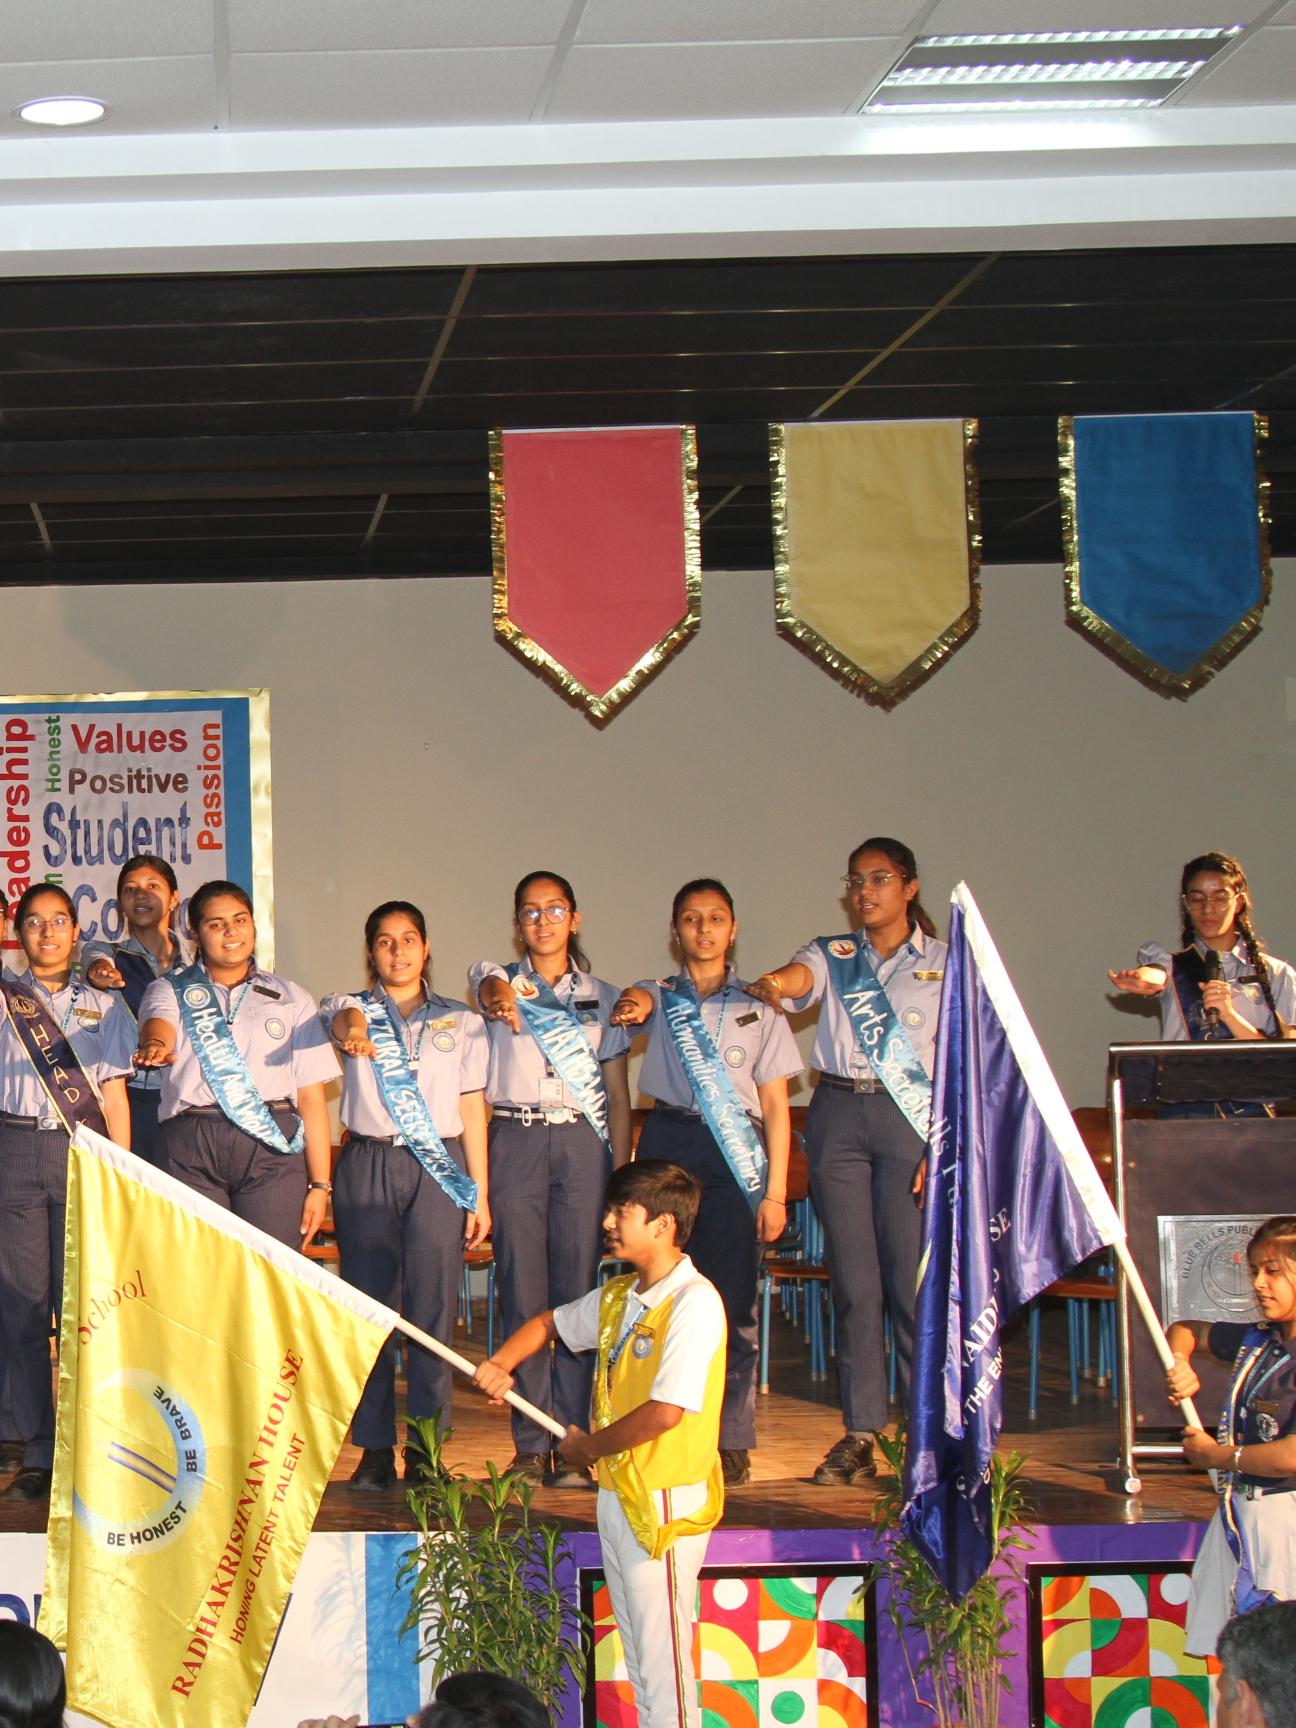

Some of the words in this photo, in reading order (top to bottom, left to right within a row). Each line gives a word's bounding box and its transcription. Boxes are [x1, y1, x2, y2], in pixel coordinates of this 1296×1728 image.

[44, 715, 61, 793] Honest
[70, 723, 189, 754] Values
[68, 767, 189, 795] Positive
[197, 723, 223, 851] Passion
[42, 800, 193, 868] Student
[842, 989, 888, 1046] Arts
[29, 1023, 81, 1104] HEAD
[665, 1001, 721, 1102] Humanities
[1195, 1227, 1225, 1251] BELLS
[153, 1385, 193, 1441] BRAVE
[964, 1376, 994, 1414] THE
[185, 1449, 199, 1473] BE
[106, 1532, 126, 1547] BE
[129, 1500, 188, 1546] HONEST
[170, 1450, 271, 1700] RADHAKRISHNAN
[256, 1348, 304, 1450] HOUSE
[230, 1578, 256, 1646] HONING
[249, 1510, 281, 1589] LATENT
[272, 1431, 306, 1509] TALENT
